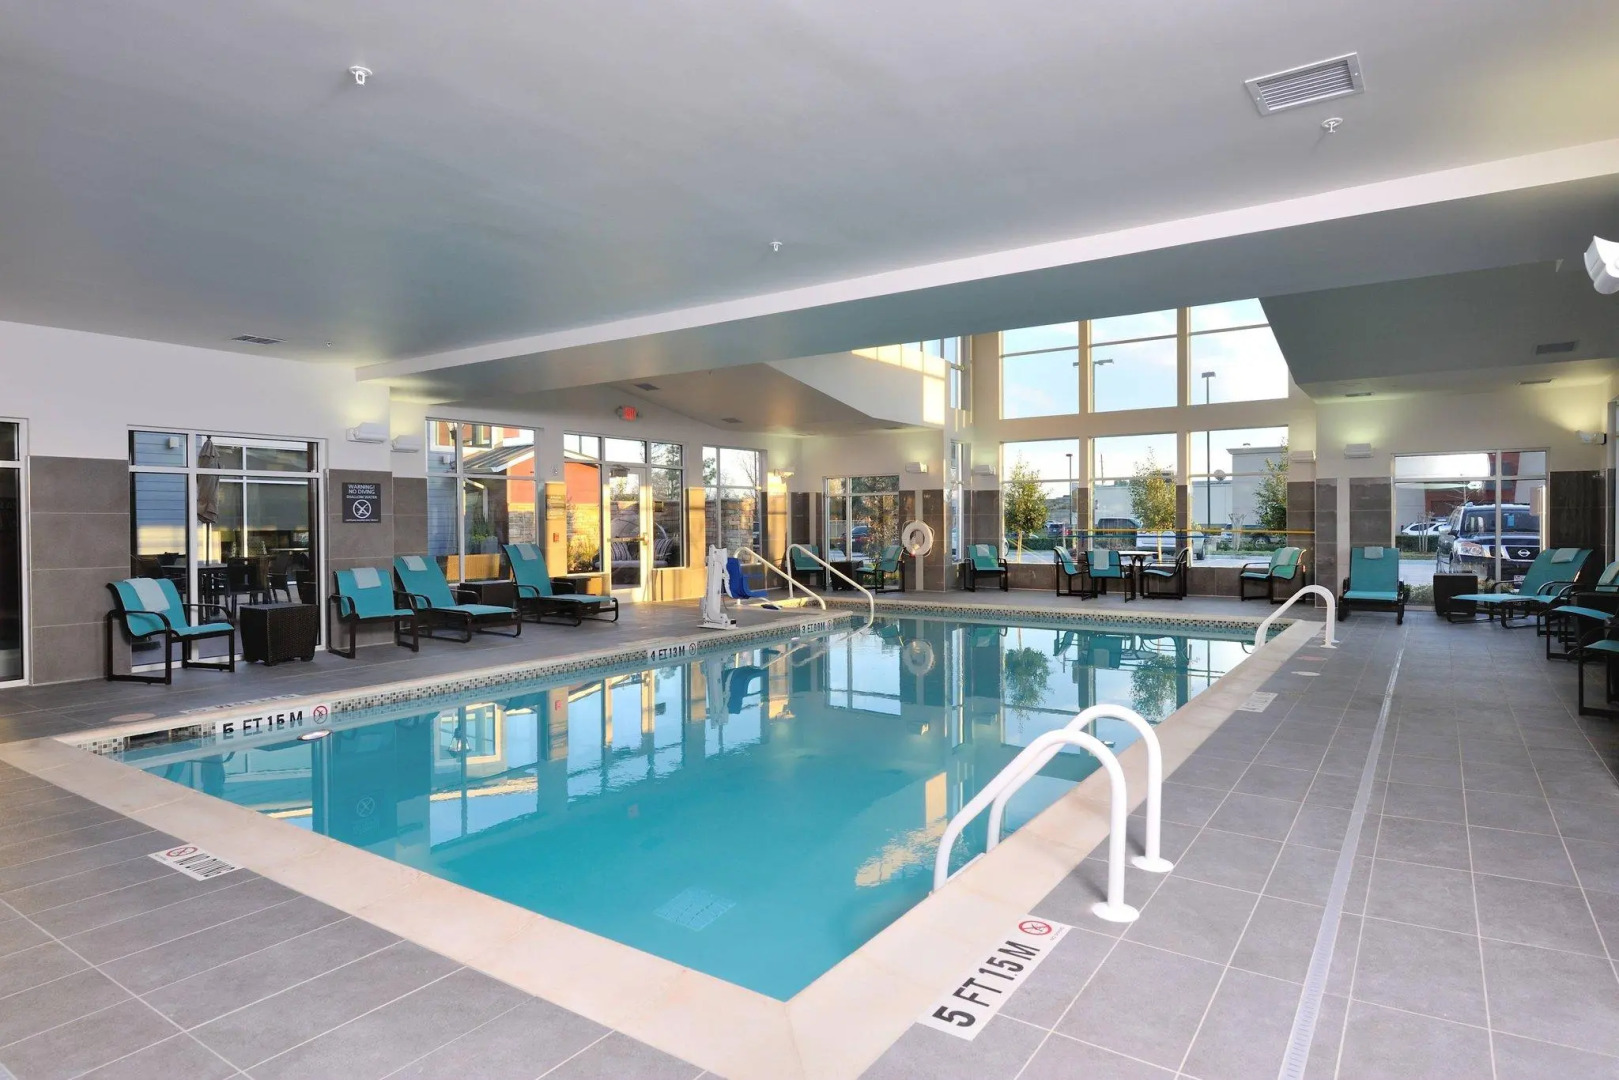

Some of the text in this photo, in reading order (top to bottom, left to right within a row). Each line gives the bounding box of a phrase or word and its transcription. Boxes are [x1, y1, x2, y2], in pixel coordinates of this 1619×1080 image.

[223, 723, 234, 733] 5
[290, 711, 303, 723] M
[997, 940, 1040, 961] M
[952, 977, 1003, 1007] FT
[932, 1005, 976, 1027] 5
